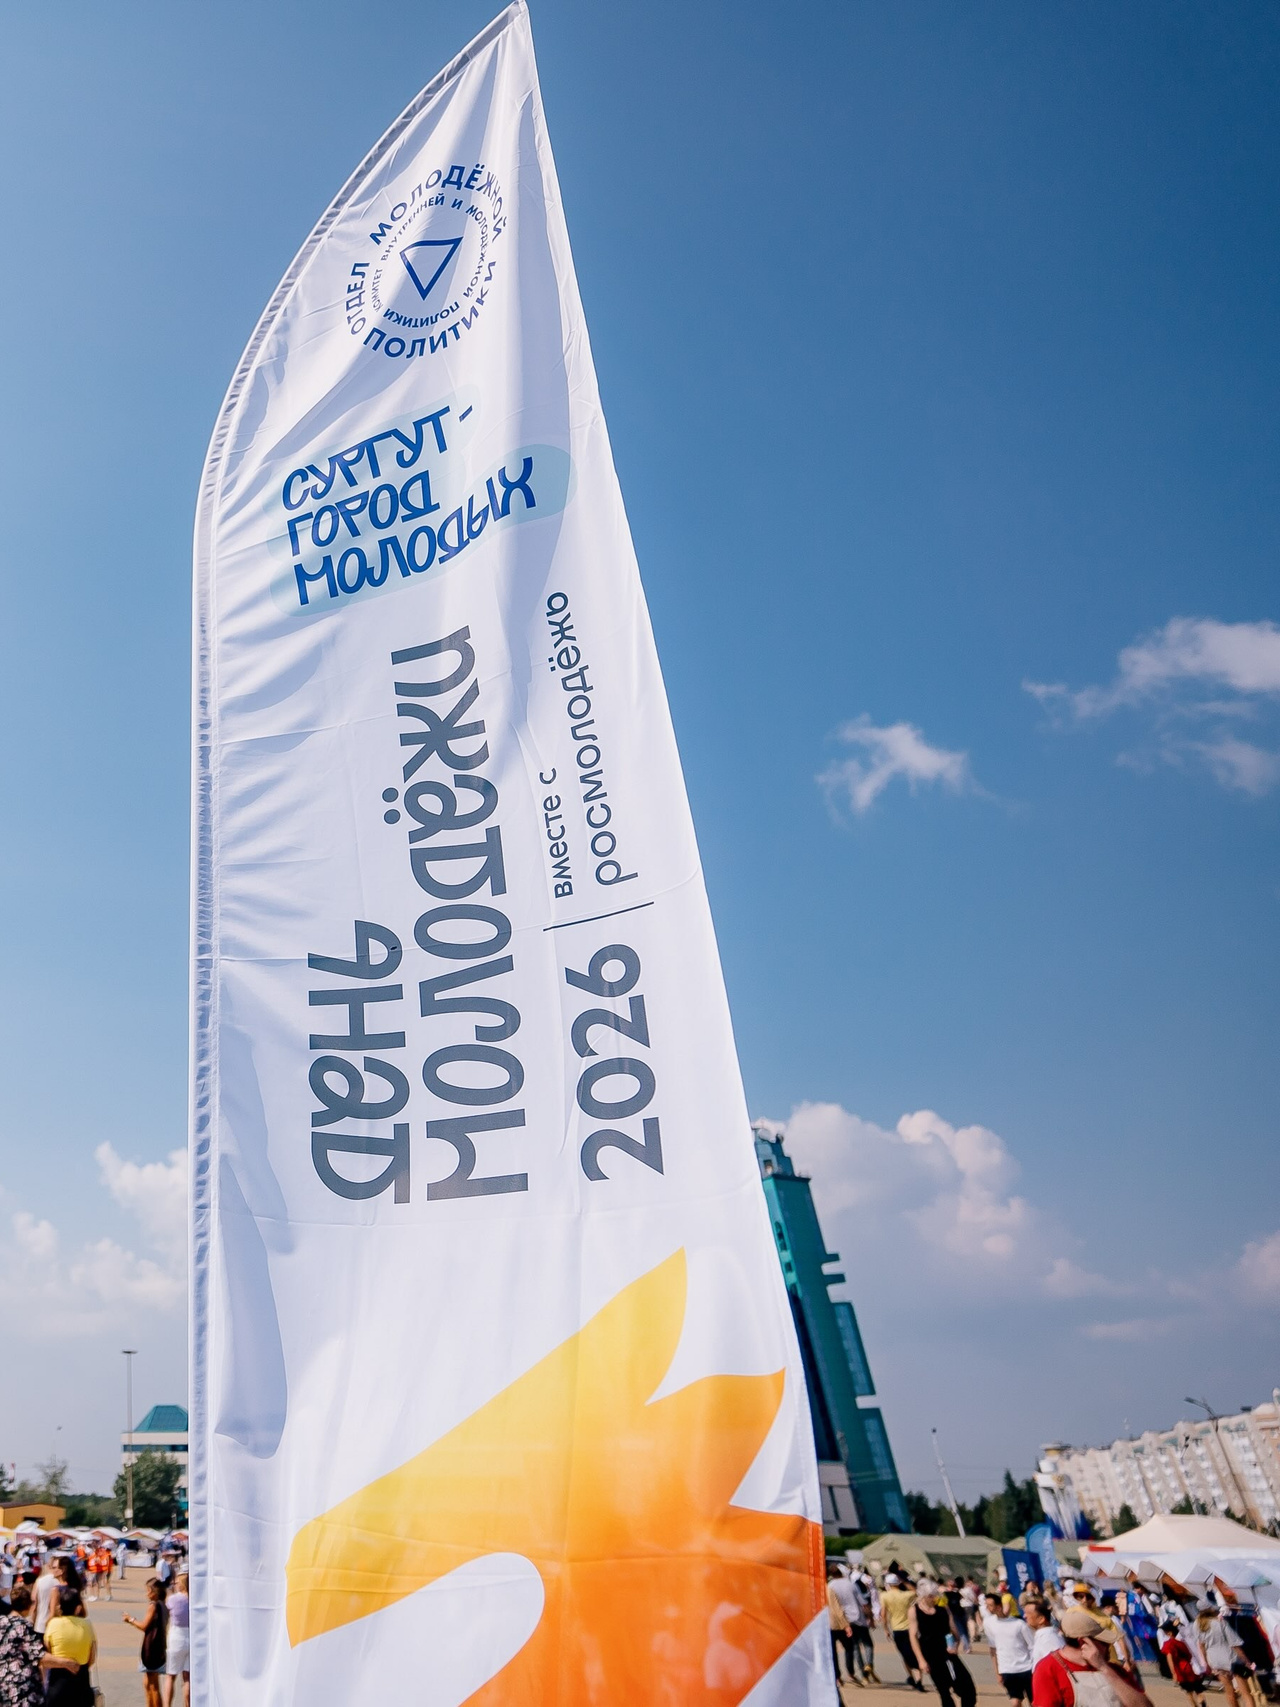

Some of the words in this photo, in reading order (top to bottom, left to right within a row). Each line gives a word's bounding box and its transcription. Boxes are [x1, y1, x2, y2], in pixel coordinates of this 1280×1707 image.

[345, 262, 370, 336] ОТДЕЛ
[369, 163, 508, 246] МОЛОДЁЖНОЙ
[380, 193, 445, 262] ВНУТРЕННЕЙ
[450, 198, 464, 210] И
[362, 261, 497, 359] ПОЛИТИКИ
[371, 268, 383, 312] КОМИТЕТ
[382, 301, 461, 329] ПОЛИТИКИ
[282, 405, 451, 511] СУРГУТ
[286, 469, 441, 557] ГОРОД
[293, 456, 537, 606] МОЛОДЫХ
[546, 591, 639, 886] росмолодёжь
[564, 943, 665, 1182] 2026
